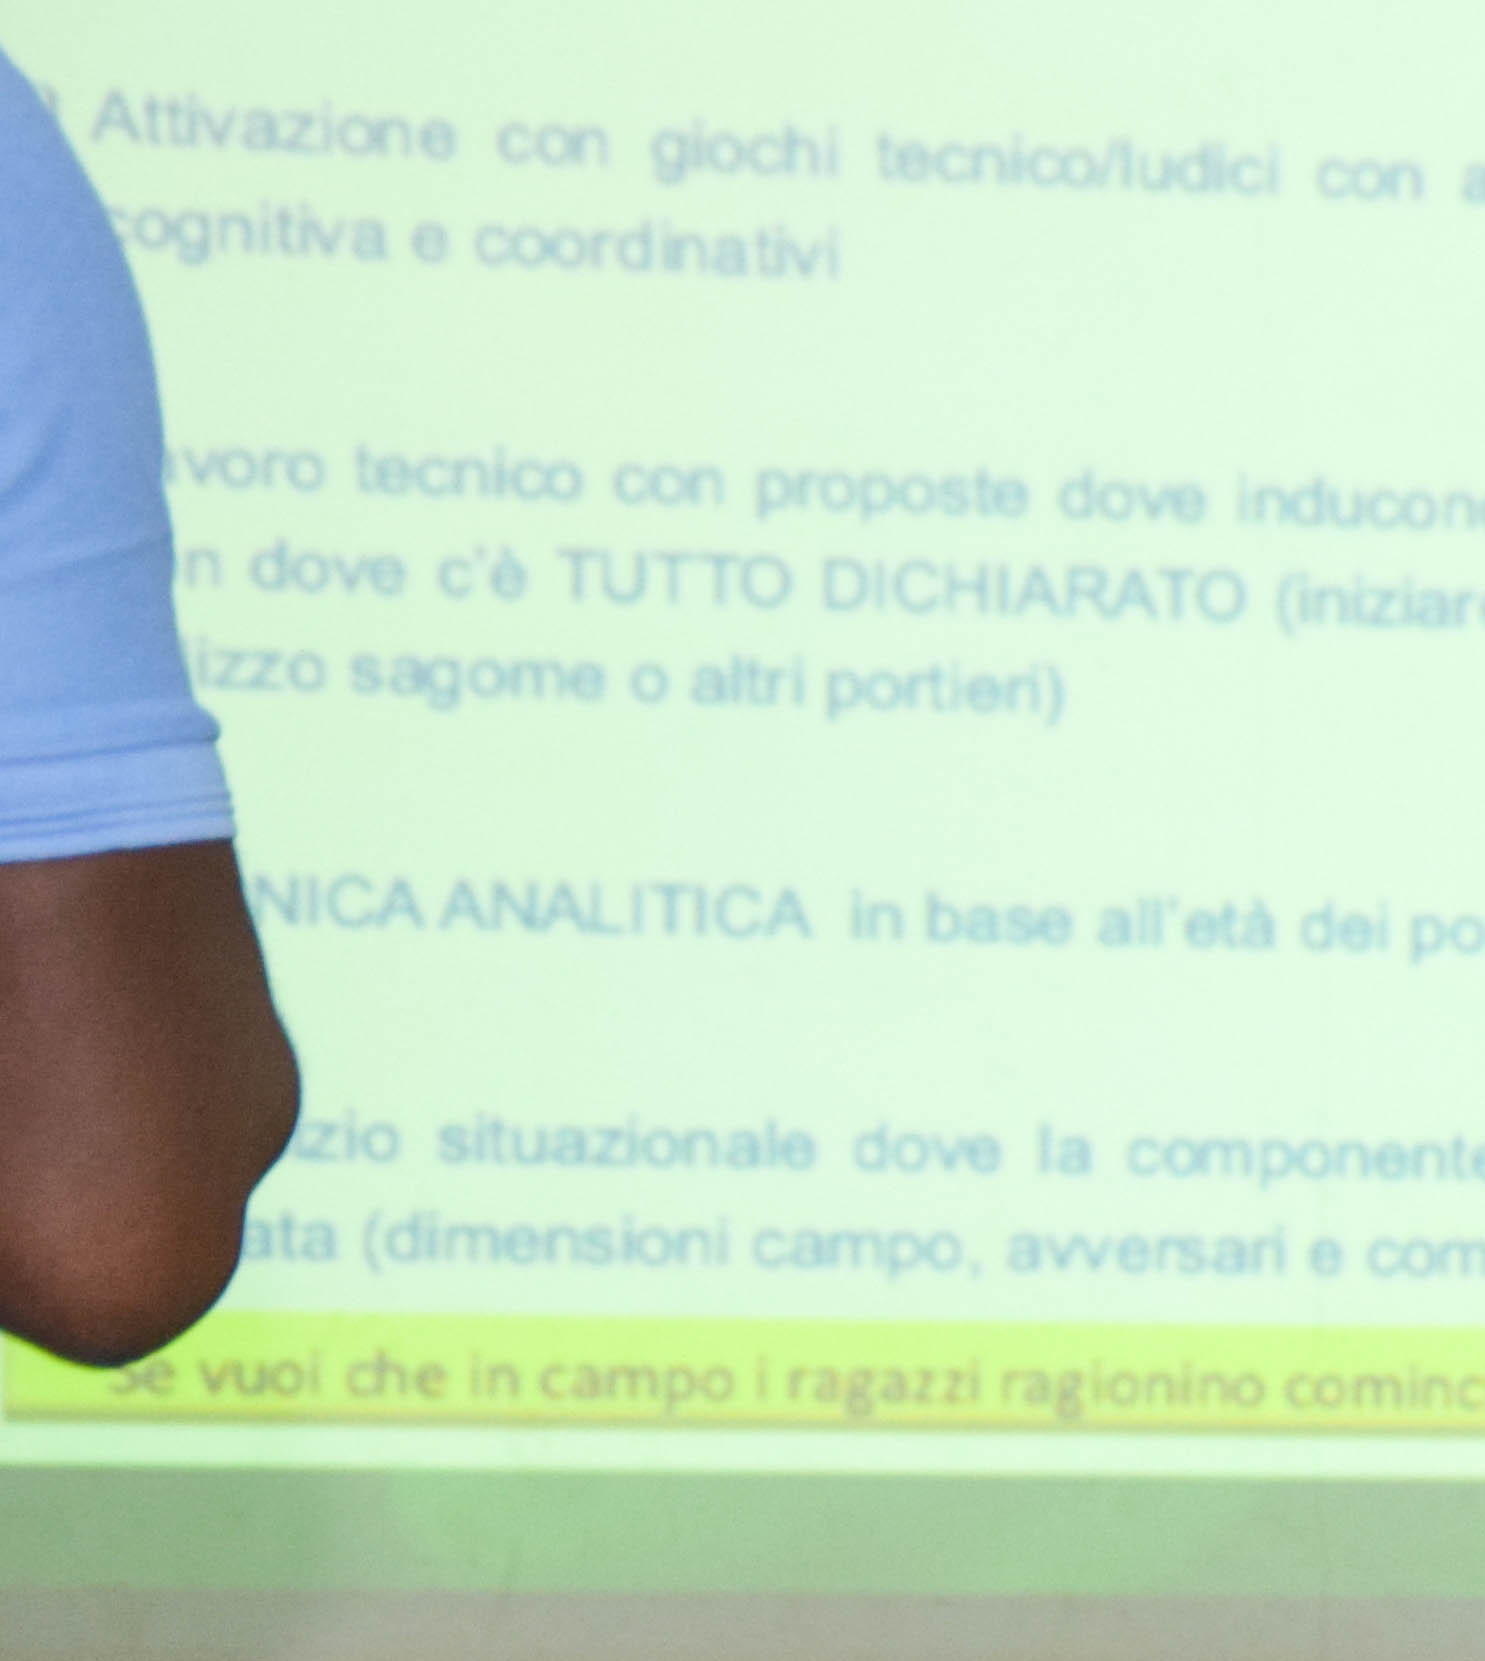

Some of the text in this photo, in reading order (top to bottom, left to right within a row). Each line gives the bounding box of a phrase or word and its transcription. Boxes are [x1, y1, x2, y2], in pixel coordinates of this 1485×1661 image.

[90, 88, 459, 162] Attivazione
[495, 121, 609, 167] con
[648, 119, 841, 187] giochi
[875, 131, 1282, 199] tecnico/ludici
[1315, 156, 1427, 203] con
[410, 221, 450, 265] e
[474, 219, 841, 280] coordinativi
[354, 443, 586, 506] tecnico
[610, 462, 727, 509] con
[753, 465, 1033, 525] proposte
[1054, 465, 1211, 528] dove
[247, 537, 409, 600] dove
[556, 545, 797, 613] TUTTO
[820, 554, 1251, 628] DICHIARATO
[348, 652, 608, 715] sagome
[627, 660, 673, 708] o
[687, 652, 808, 709] altri
[824, 659, 1068, 729] portieri)
[436, 877, 816, 942] ANALITICA
[847, 887, 908, 943] in
[920, 888, 1077, 950] base
[1094, 893, 1279, 954] all'età
[1297, 898, 1393, 956] dei
[435, 1110, 820, 1174] situazionale
[850, 1119, 1005, 1178] dove
[1034, 1119, 1096, 1179] la
[361, 1209, 730, 1275] (dimensioni
[751, 1226, 982, 1284] campo,
[1005, 1222, 1289, 1279] avversari
[1305, 1235, 1346, 1280] e
[199, 1346, 320, 1400] vuoi
[345, 1350, 447, 1402] che
[471, 1352, 521, 1402] in
[538, 1362, 734, 1417] campo
[755, 1354, 770, 1404] i
[787, 1358, 980, 1421] ragazzi
[1002, 1358, 1266, 1423] ragionino
